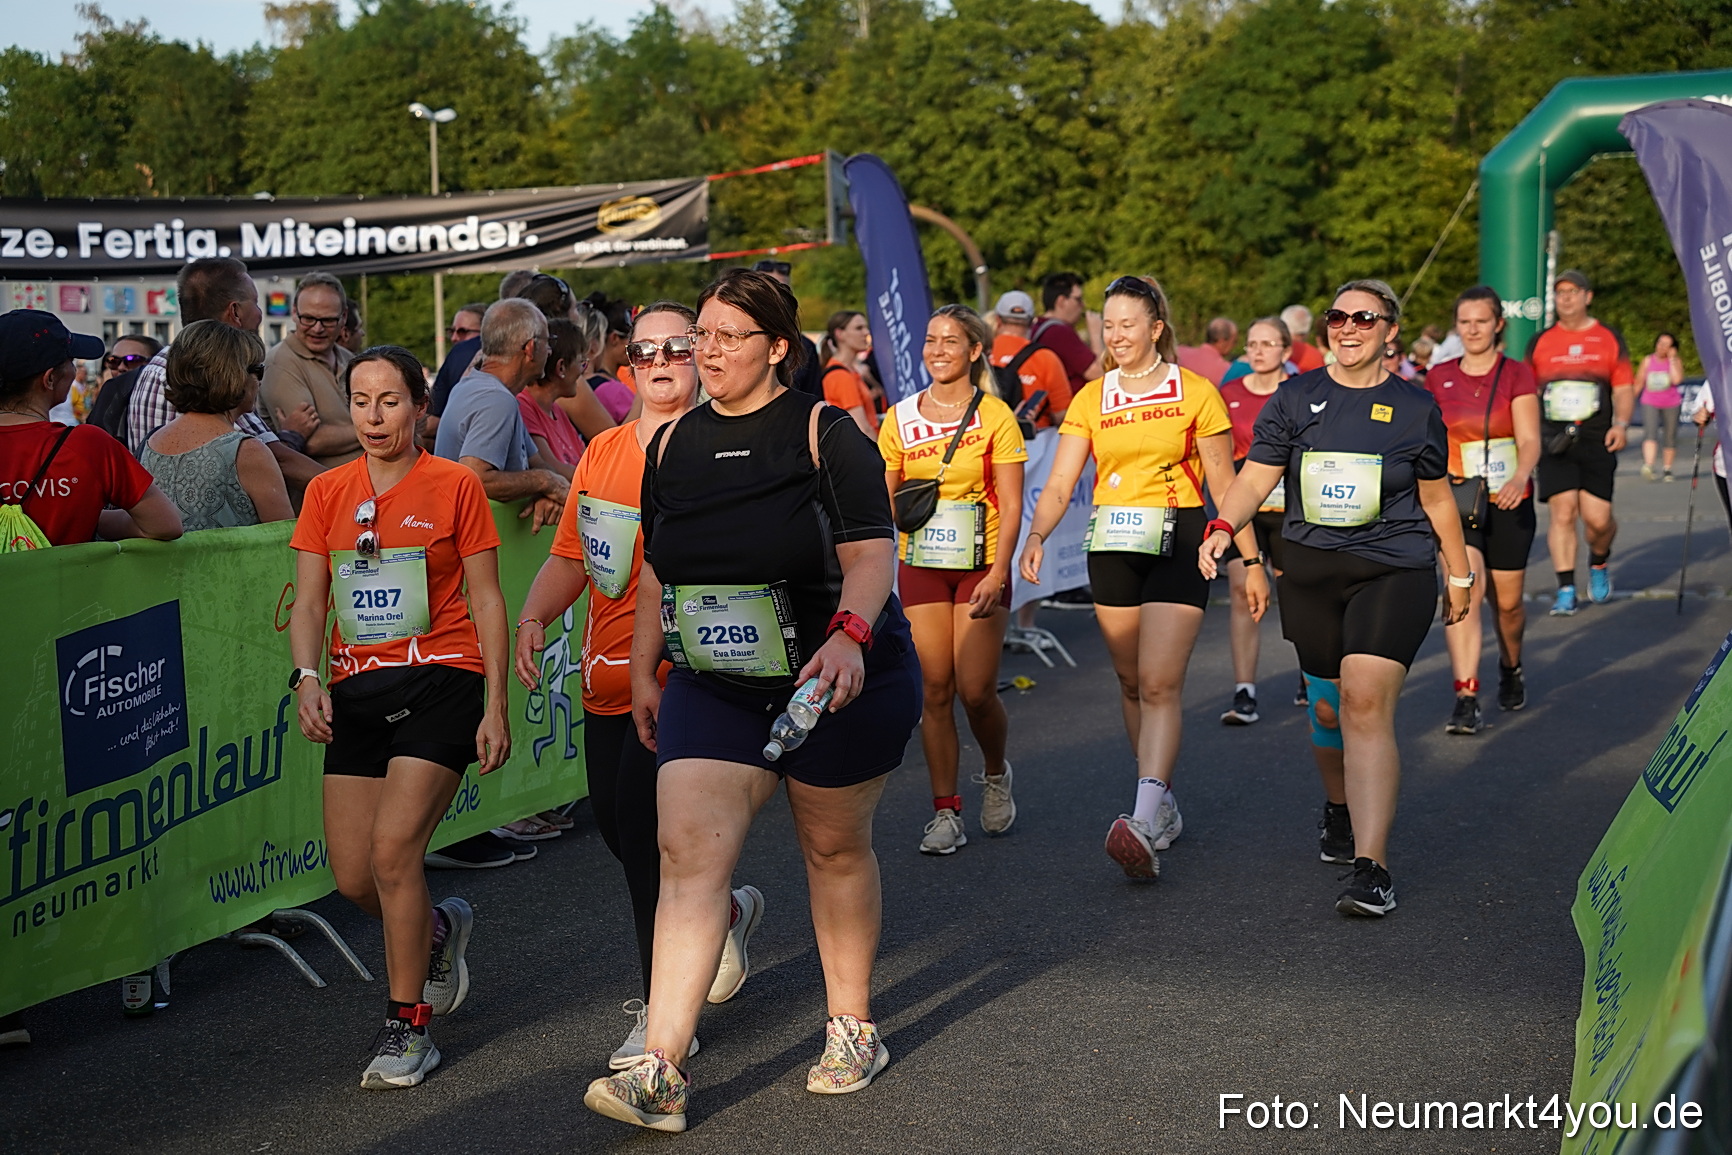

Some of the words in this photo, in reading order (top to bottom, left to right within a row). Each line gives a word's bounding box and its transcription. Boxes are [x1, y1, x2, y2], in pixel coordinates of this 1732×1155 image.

[1, 228, 68, 258] ze.
[78, 218, 231, 263] Fertig.
[240, 216, 539, 258] Miteinander.
[1501, 300, 1523, 318] OK
[1100, 413, 1136, 429] MAX
[1142, 406, 1185, 421] BÖGL
[907, 445, 939, 461] MAX
[1321, 484, 1356, 499] 457
[400, 515, 433, 529] Marina
[1110, 512, 1143, 526] 1615
[924, 528, 957, 542] 1758
[352, 589, 401, 608] 2187
[357, 613, 385, 621] Marina
[386, 612, 403, 620] Orel
[697, 625, 759, 645] 2268
[713, 650, 729, 658] Eva
[730, 649, 755, 657] Bauer
[788, 641, 798, 668] HILTL
[84, 656, 166, 706] Fischer
[96, 684, 162, 719] AUTOMOBILE
[119, 724, 140, 746] und
[9, 693, 292, 900] firmenlauf
[13, 847, 159, 937] neumarkt
